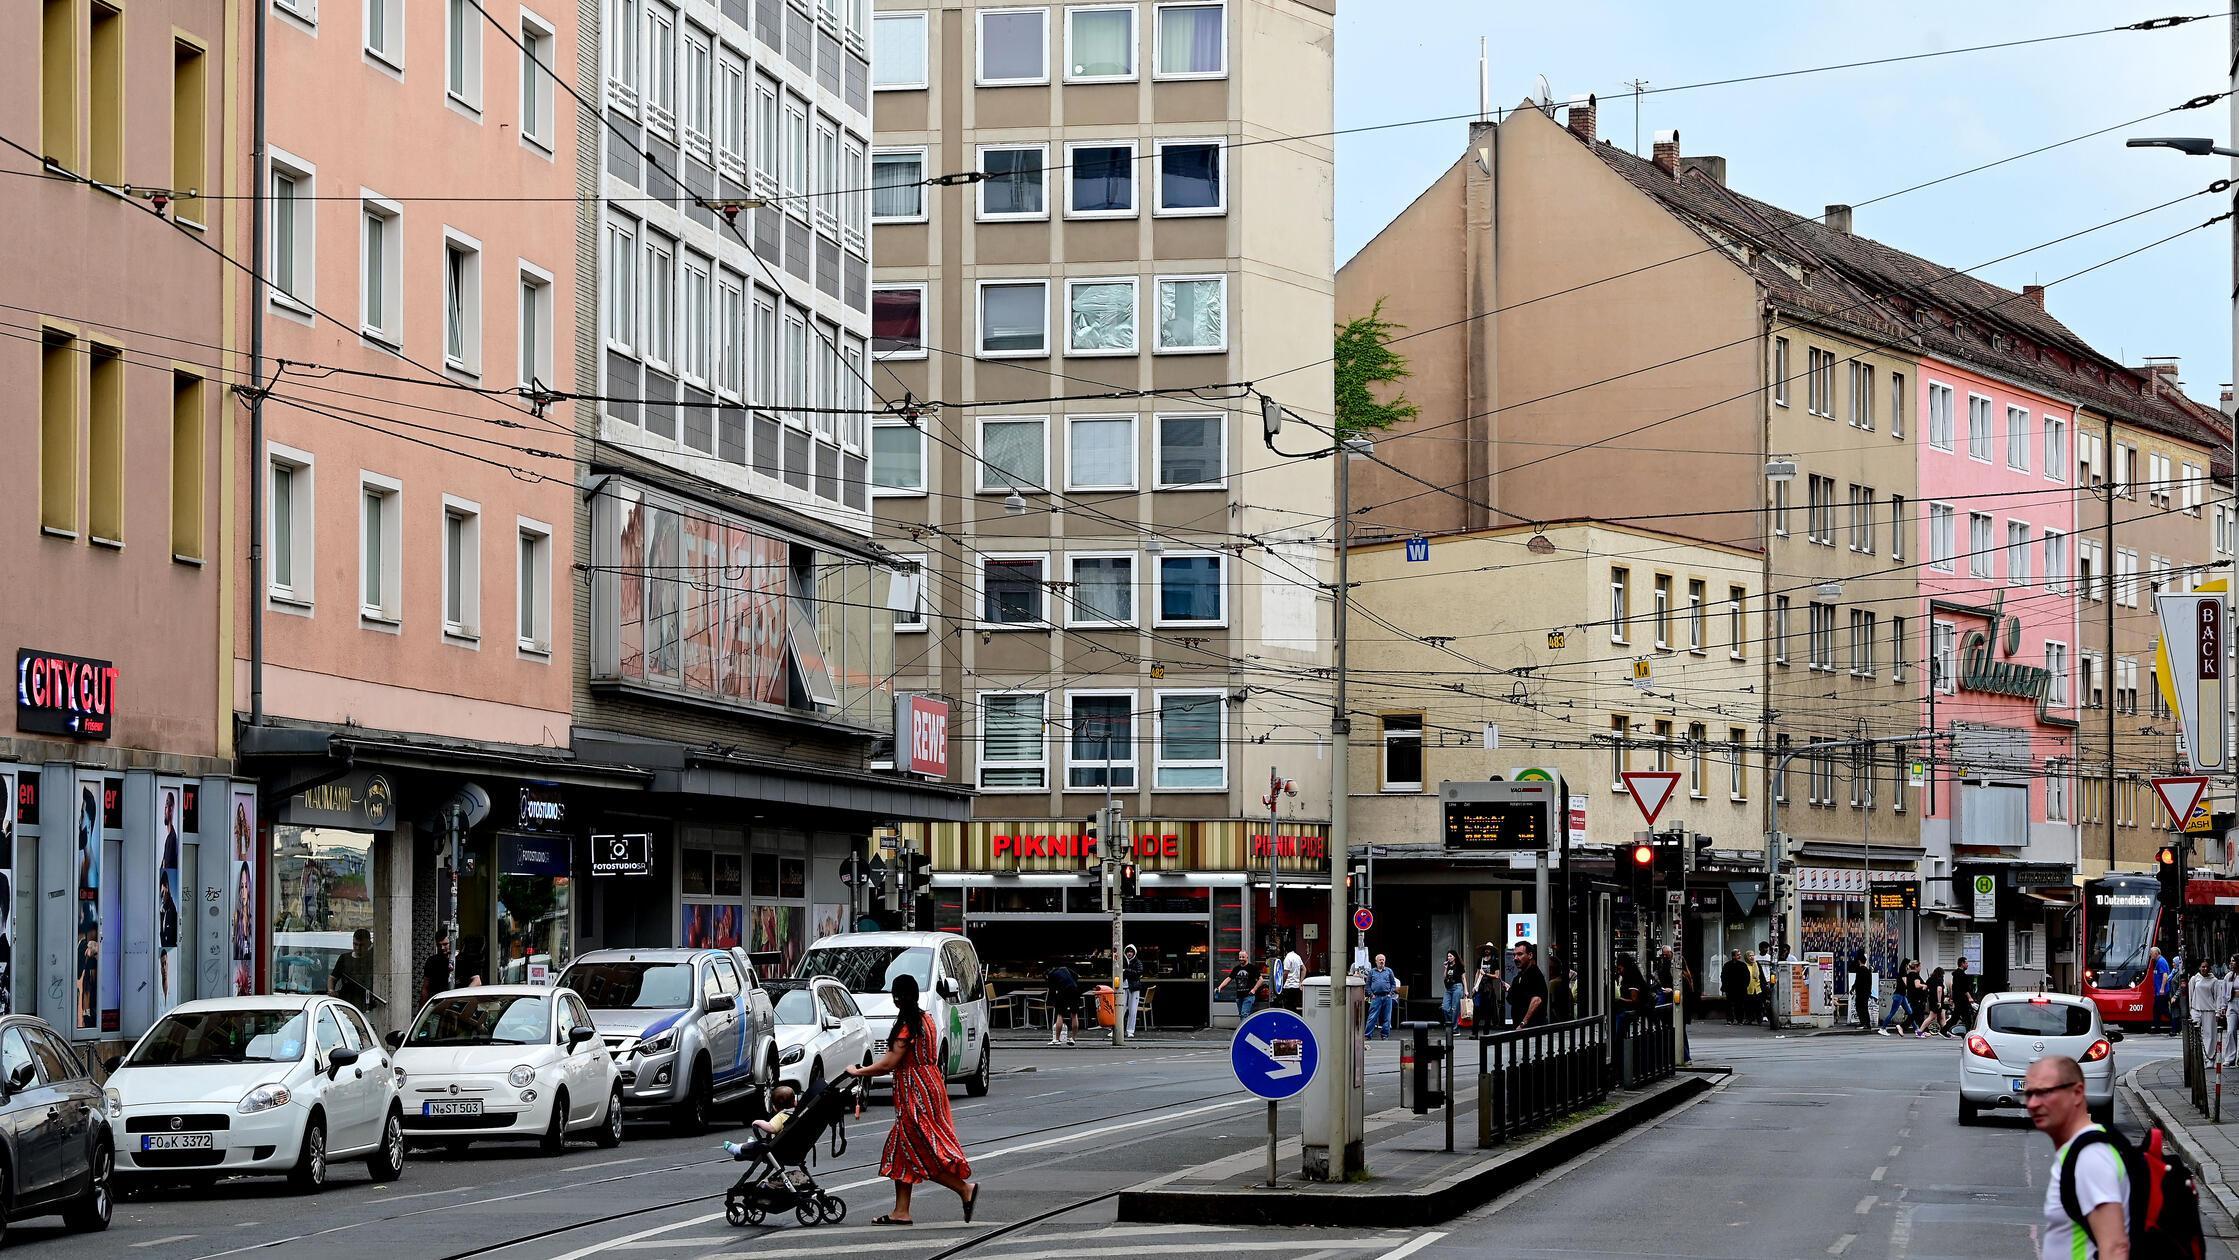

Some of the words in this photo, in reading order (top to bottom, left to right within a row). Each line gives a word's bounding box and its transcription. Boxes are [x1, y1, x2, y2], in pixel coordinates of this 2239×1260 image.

[1409, 544, 1426, 561] W
[1549, 635, 1564, 648] 483
[2202, 608, 2216, 674] BACK
[32, 657, 79, 709] CITY
[80, 663, 120, 716] CUT
[913, 709, 946, 764] REWE
[304, 784, 351, 812] NAUMANN
[2129, 1004, 2144, 1012] 2007
[432, 1104, 439, 1113] N
[445, 1103, 458, 1113] ST
[460, 1103, 478, 1113] 503
[149, 1136, 164, 1148] FO
[171, 1136, 178, 1147] K
[182, 1135, 211, 1147] 3372
